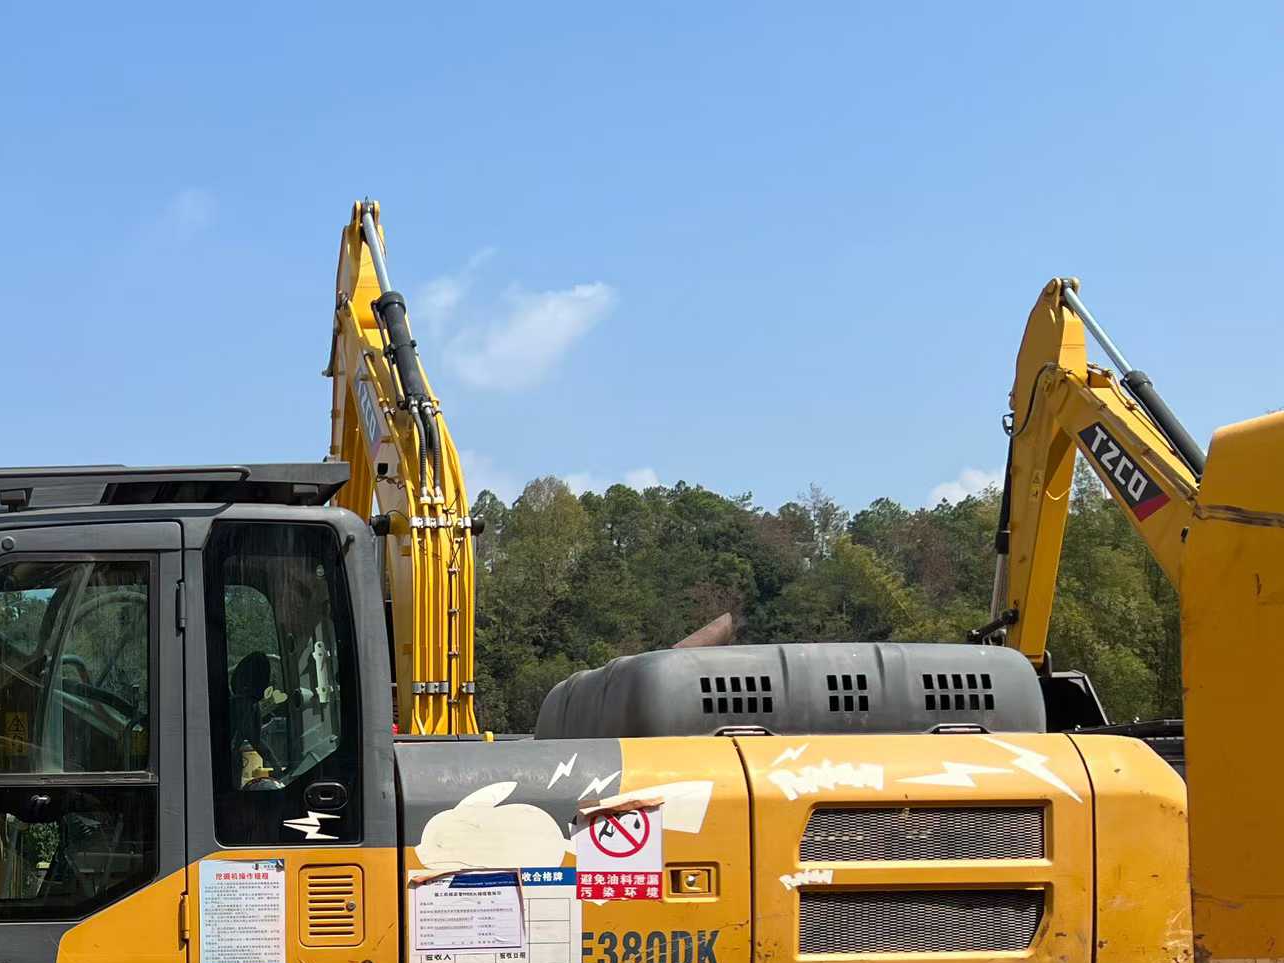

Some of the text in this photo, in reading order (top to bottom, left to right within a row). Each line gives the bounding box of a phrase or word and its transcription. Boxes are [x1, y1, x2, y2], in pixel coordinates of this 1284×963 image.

[1090, 425, 1149, 502] TZCO
[579, 872, 660, 886] 避免油料泄漏
